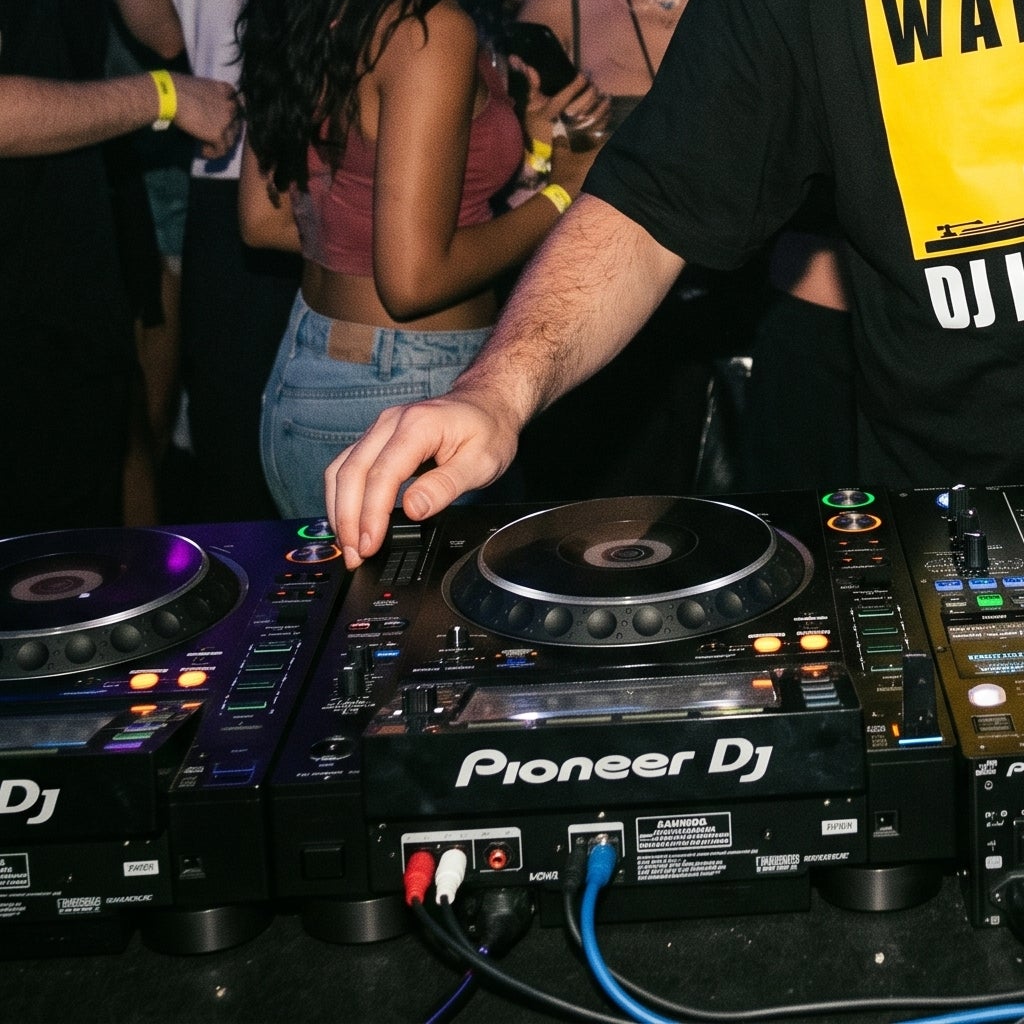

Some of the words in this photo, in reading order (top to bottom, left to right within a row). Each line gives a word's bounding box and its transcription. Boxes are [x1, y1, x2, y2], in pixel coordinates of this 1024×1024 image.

[924, 259, 996, 329] DJ
[455, 749, 696, 787] Pioneer
[708, 737, 774, 783] DJ
